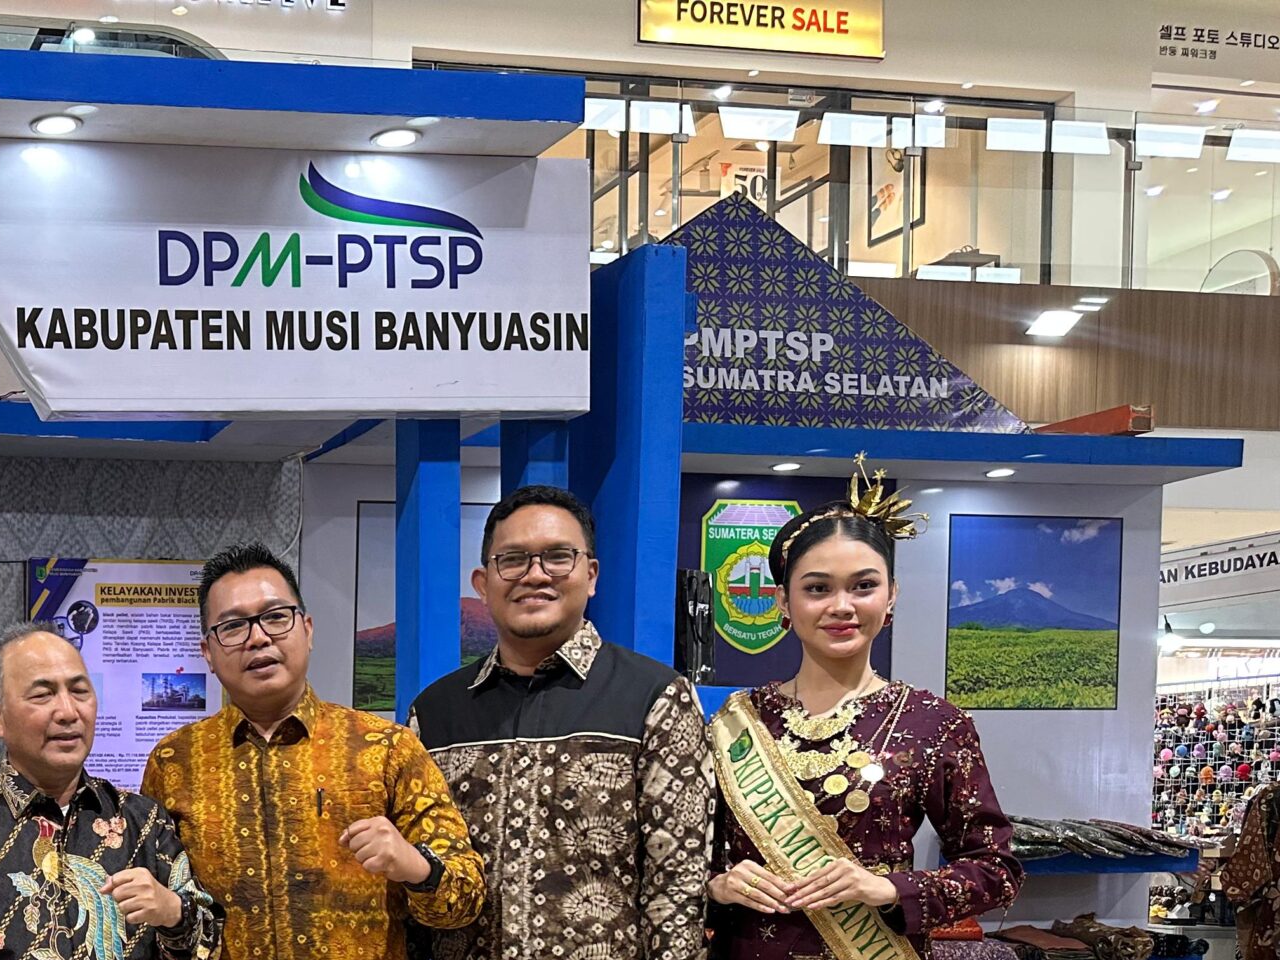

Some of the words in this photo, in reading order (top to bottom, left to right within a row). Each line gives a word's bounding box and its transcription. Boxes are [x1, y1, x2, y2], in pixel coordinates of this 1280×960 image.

[676, 0, 785, 29] FOREVER
[791, 8, 849, 34] SALE
[1159, 25, 1186, 41] 셀프
[1192, 28, 1219, 44] 포토
[1225, 31, 1280, 50] 스튜디오
[158, 230, 483, 290] DPM-PTSP
[16, 307, 251, 351] KABUPATEN
[265, 309, 361, 351] MUSI
[368, 311, 589, 352] BANYUASIN
[683, 365, 816, 393] SUMATRA
[824, 372, 949, 399] SELATAN
[708, 527, 761, 540] SUMATERA
[1184, 551, 1280, 580] KEBUDAYA
[100, 586, 162, 597] KELAYAKAN
[165, 587, 201, 597] INVEST
[100, 597, 152, 605] pembangunan
[723, 623, 757, 641] BERSATU
[758, 625, 783, 640] TEGUH
[733, 754, 798, 836] KUPEK
[773, 820, 835, 878] MUS
